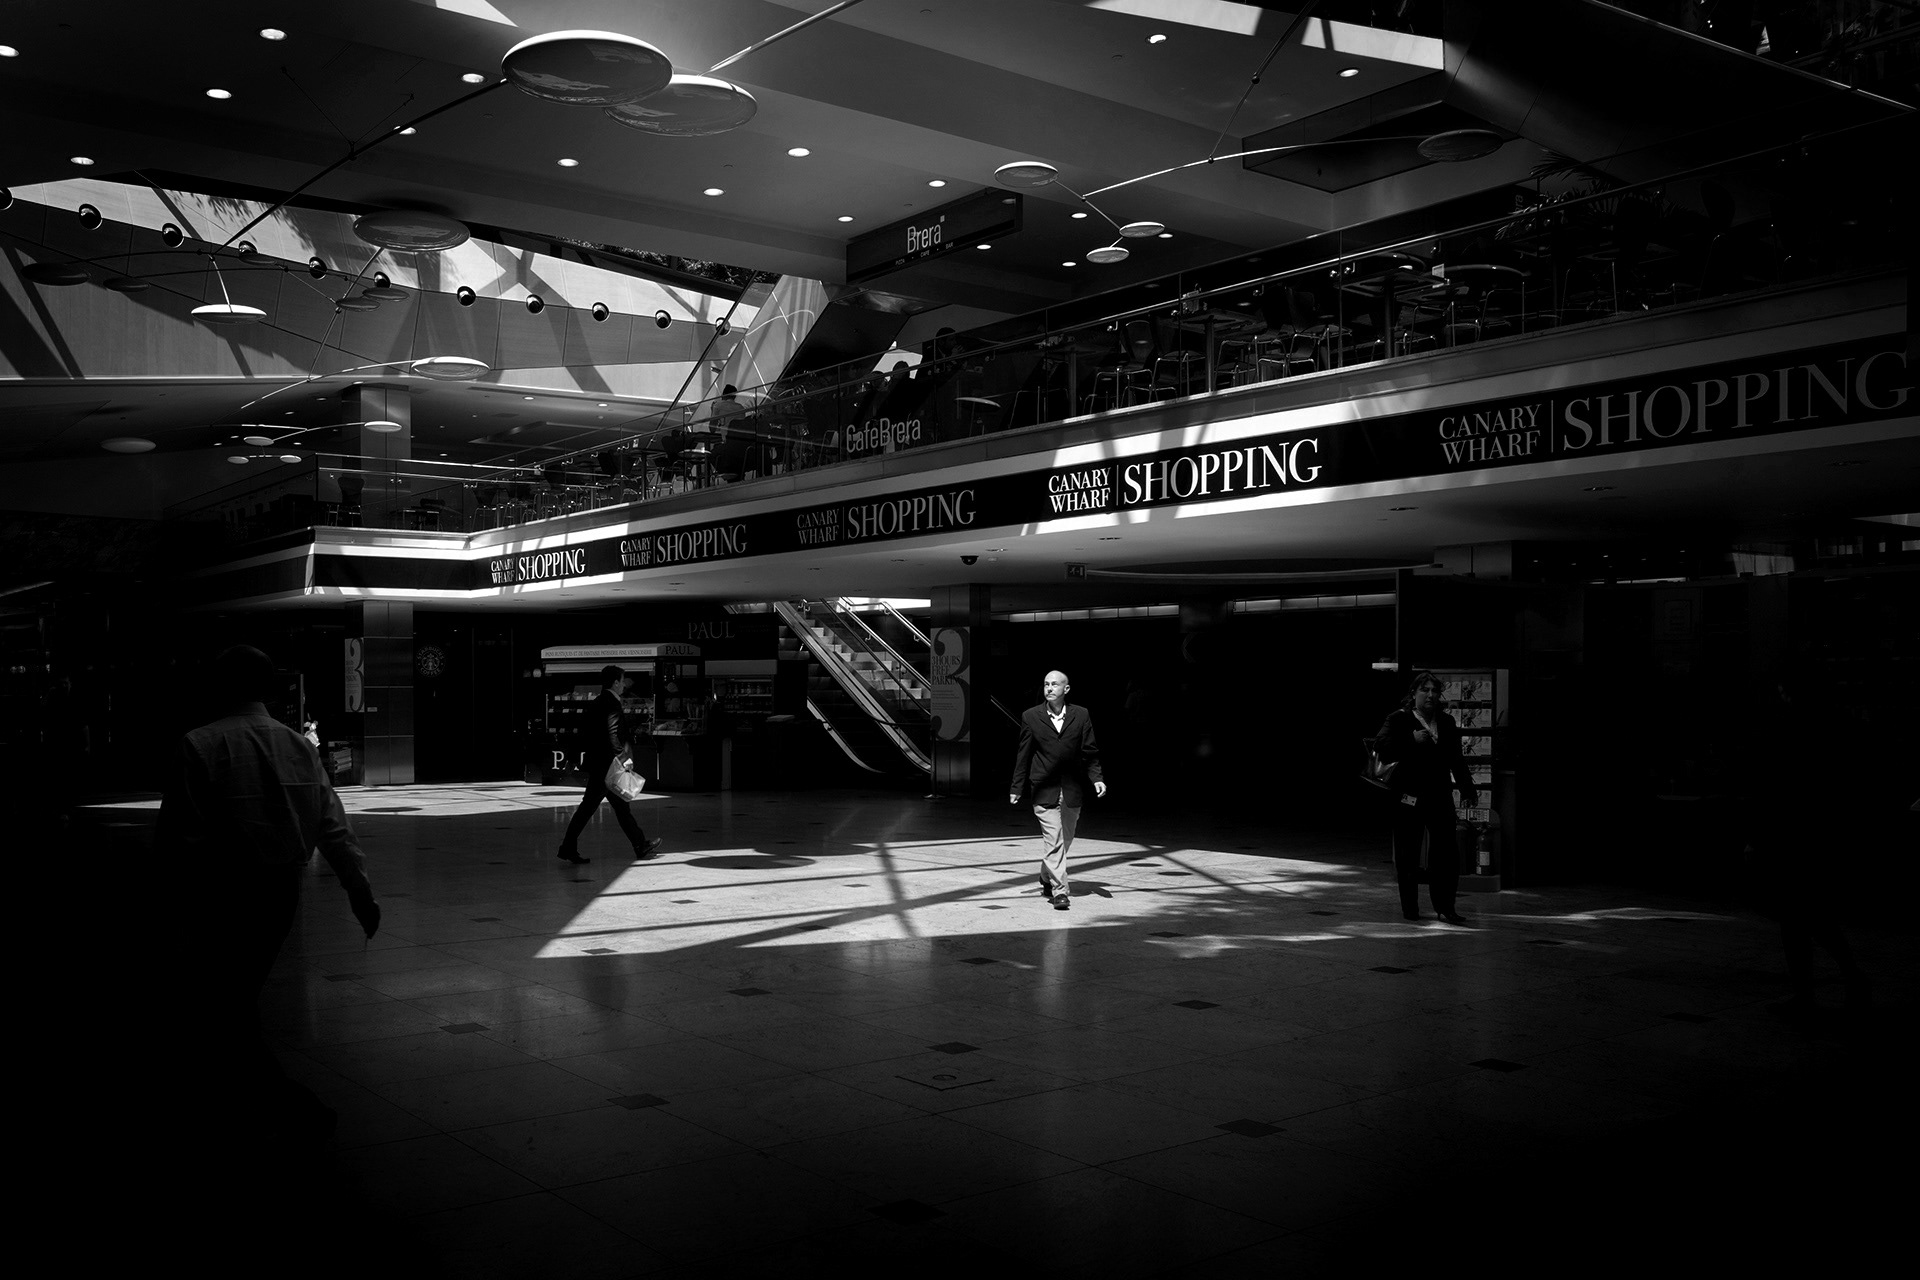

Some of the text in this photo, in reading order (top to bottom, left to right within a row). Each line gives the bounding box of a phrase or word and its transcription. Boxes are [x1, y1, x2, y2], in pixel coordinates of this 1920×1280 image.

[907, 224, 942, 254] Brera
[1563, 351, 1916, 450] SHOPPING
[1438, 403, 1542, 441] CANARY
[1439, 429, 1541, 465] WHARF
[1048, 466, 1111, 494] CANARY
[1123, 438, 1323, 505] SHOPPING
[847, 489, 977, 540] SHOPPING
[1049, 487, 1111, 514] WHARF
[797, 508, 840, 529] CANARY
[620, 536, 652, 554] CANARY
[656, 523, 748, 564] SHOPPING
[798, 525, 840, 545] WHARF
[490, 557, 514, 572] CANARY
[518, 548, 586, 582] SHOPPING
[621, 551, 652, 567] WHARF
[491, 569, 515, 584] WHARF
[687, 621, 736, 640] PAUL
[665, 645, 694, 656] PAUL
[930, 626, 970, 742] 3
